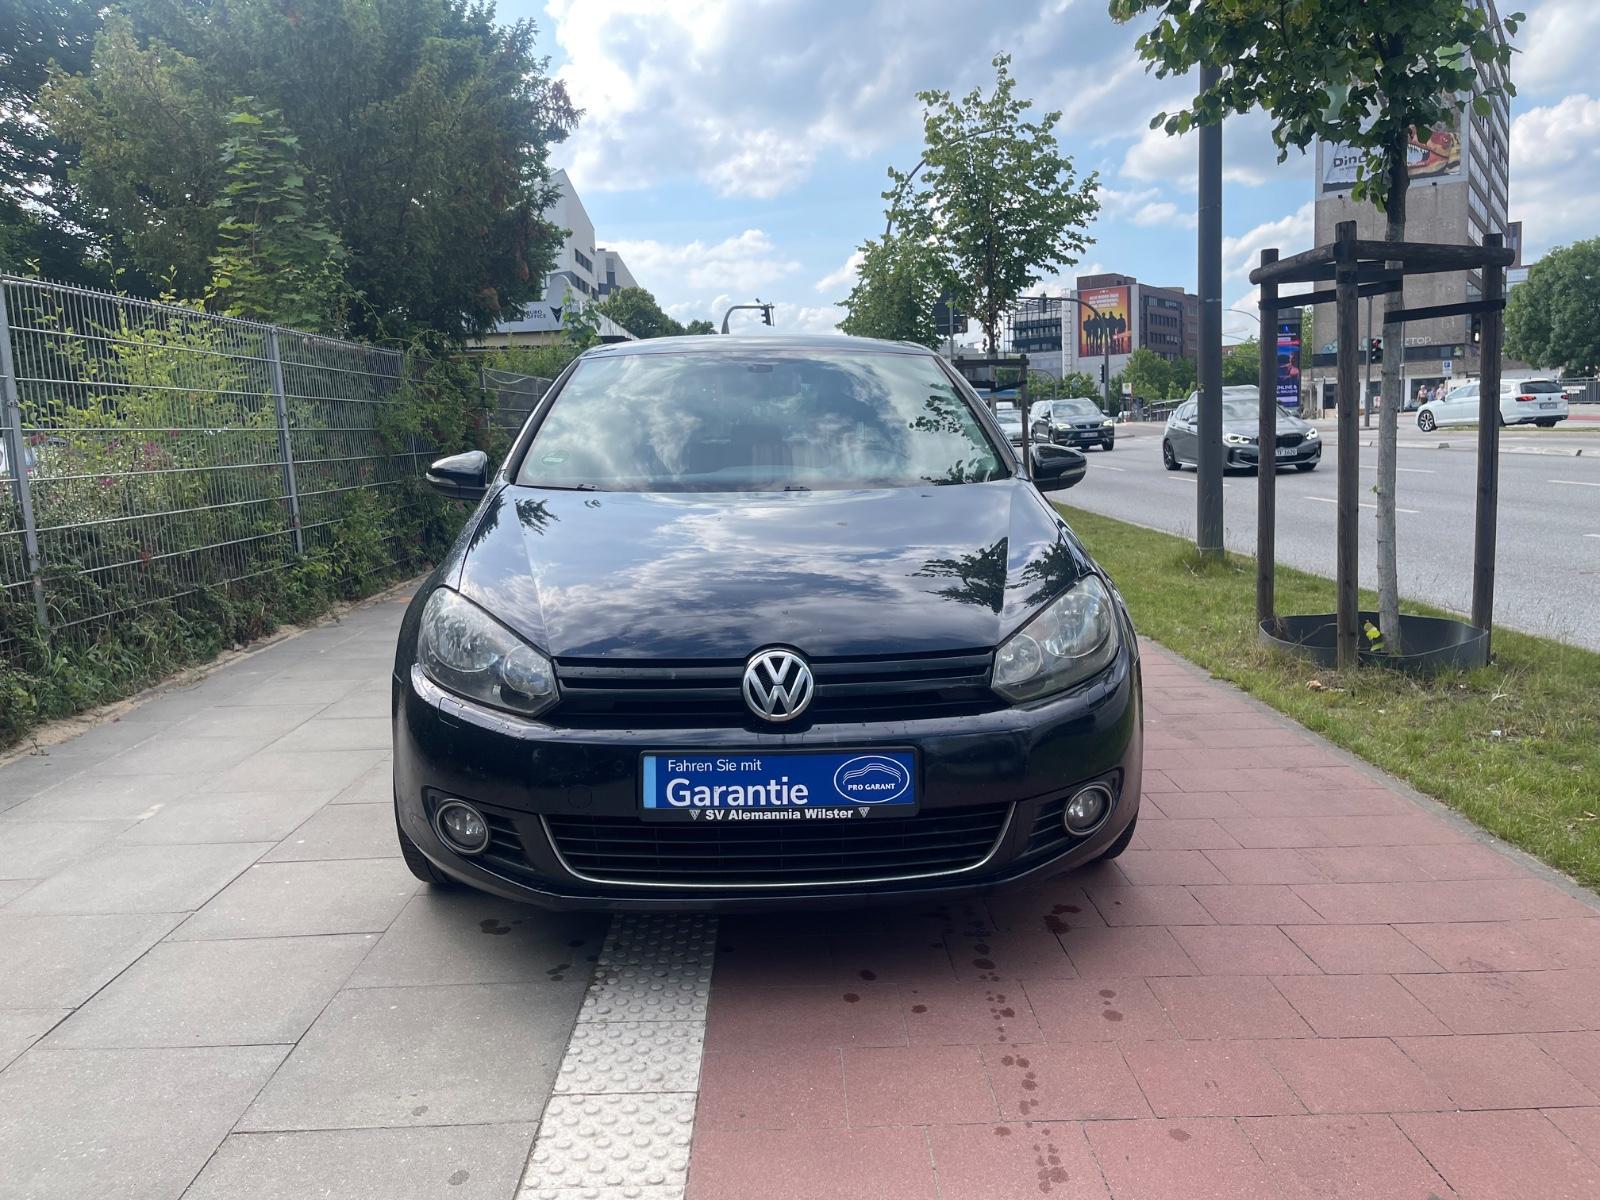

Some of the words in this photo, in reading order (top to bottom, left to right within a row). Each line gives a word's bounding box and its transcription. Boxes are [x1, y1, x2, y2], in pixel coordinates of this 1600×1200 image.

[668, 760, 713, 772] Fahren
[716, 758, 737, 771] Sie
[741, 759, 762, 771] mit
[666, 776, 808, 807] Garantie
[705, 809, 725, 820] SV
[728, 808, 801, 820] Alemannia
[804, 808, 853, 819] Wilster
